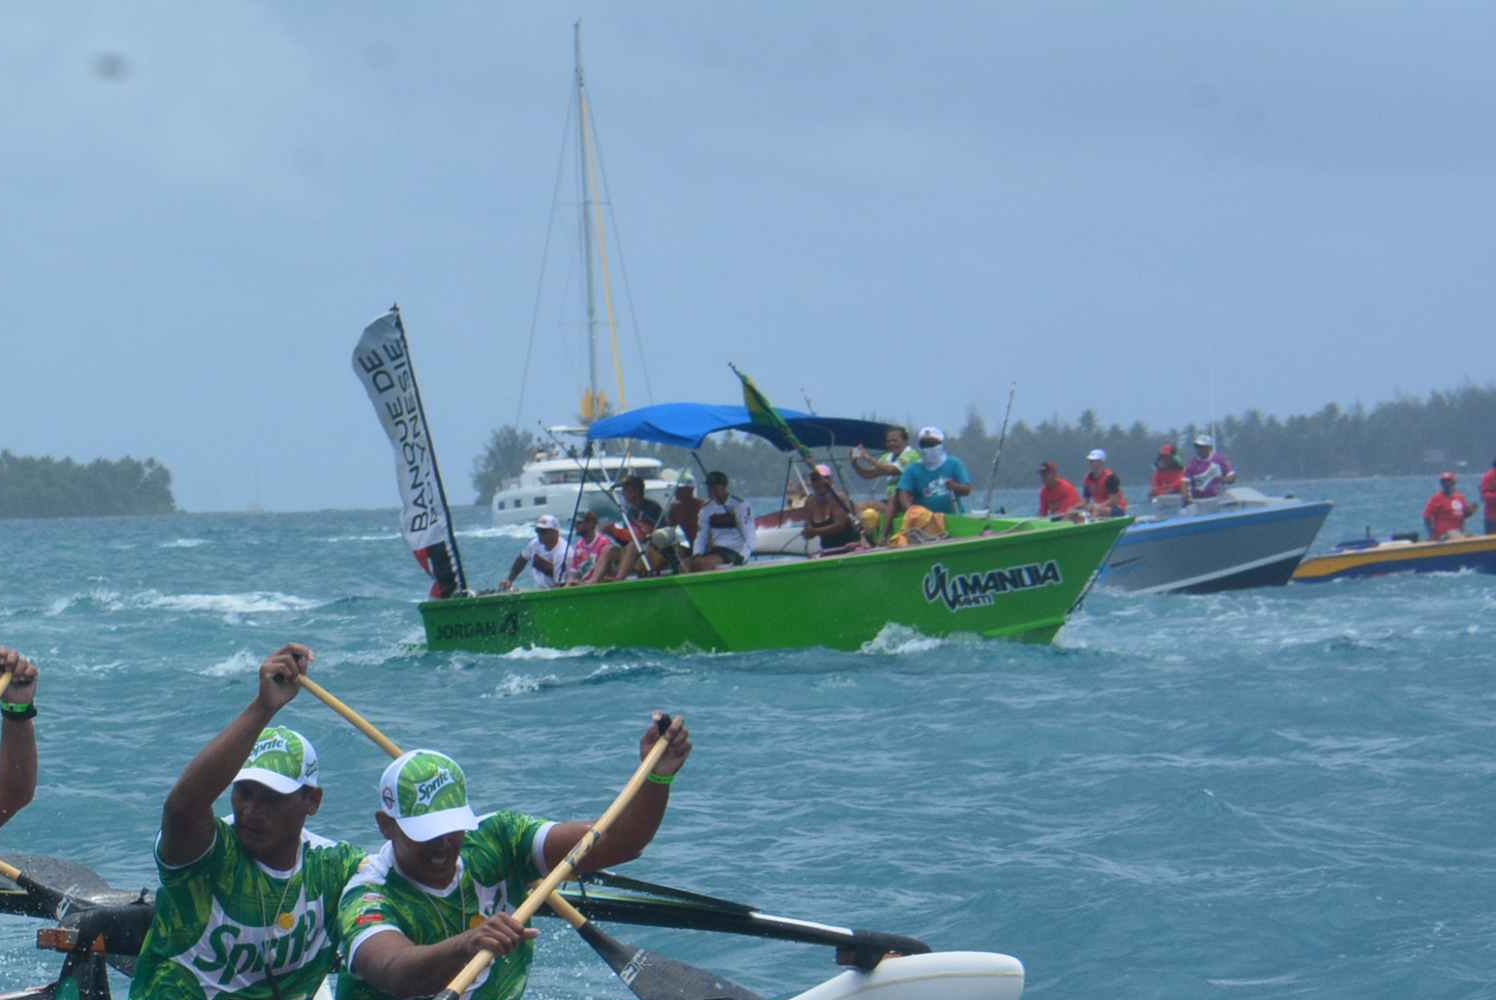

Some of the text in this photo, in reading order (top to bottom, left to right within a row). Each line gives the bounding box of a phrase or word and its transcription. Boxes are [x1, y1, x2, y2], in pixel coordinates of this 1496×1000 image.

[358, 349, 428, 532] BANQUE DE
[437, 621, 496, 640] JORDAN
[419, 769, 450, 801] Sprite
